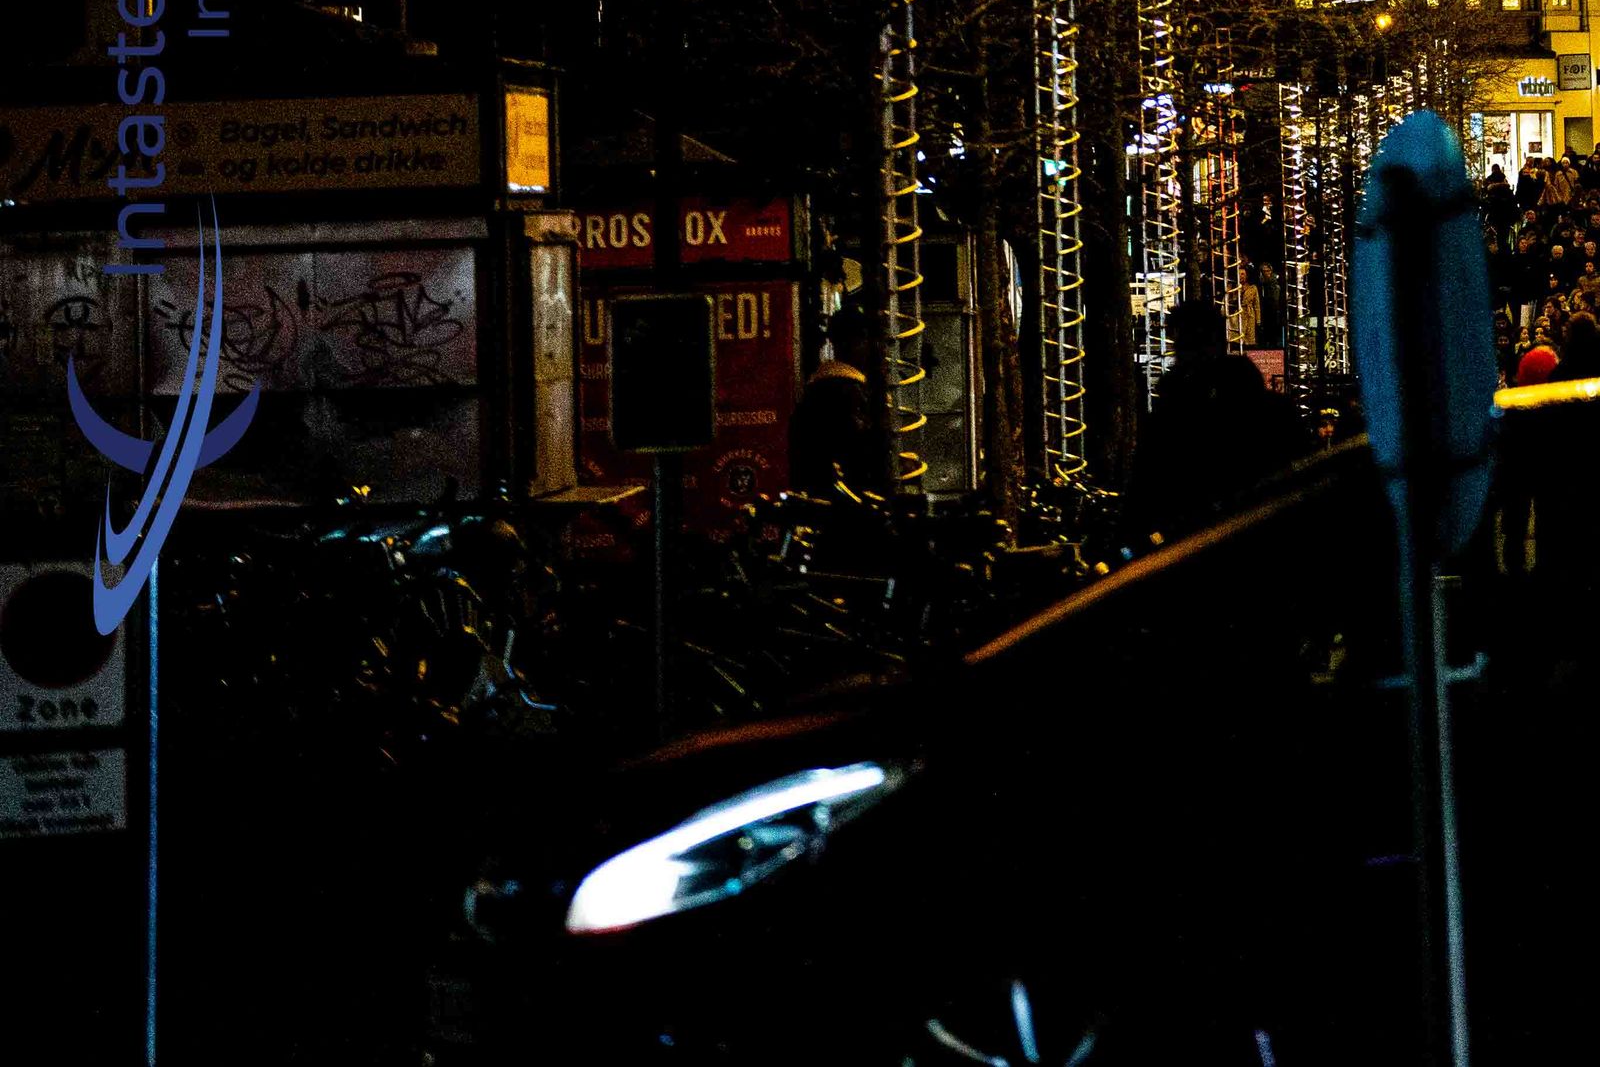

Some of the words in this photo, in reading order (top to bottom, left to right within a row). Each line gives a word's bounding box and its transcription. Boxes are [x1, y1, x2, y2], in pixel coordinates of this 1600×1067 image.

[321, 114, 468, 140] Sandwich
[219, 157, 256, 181] og
[267, 152, 347, 176] kolde
[354, 146, 445, 174] drikke
[685, 210, 728, 246] OX
[16, 693, 99, 721] Zone
